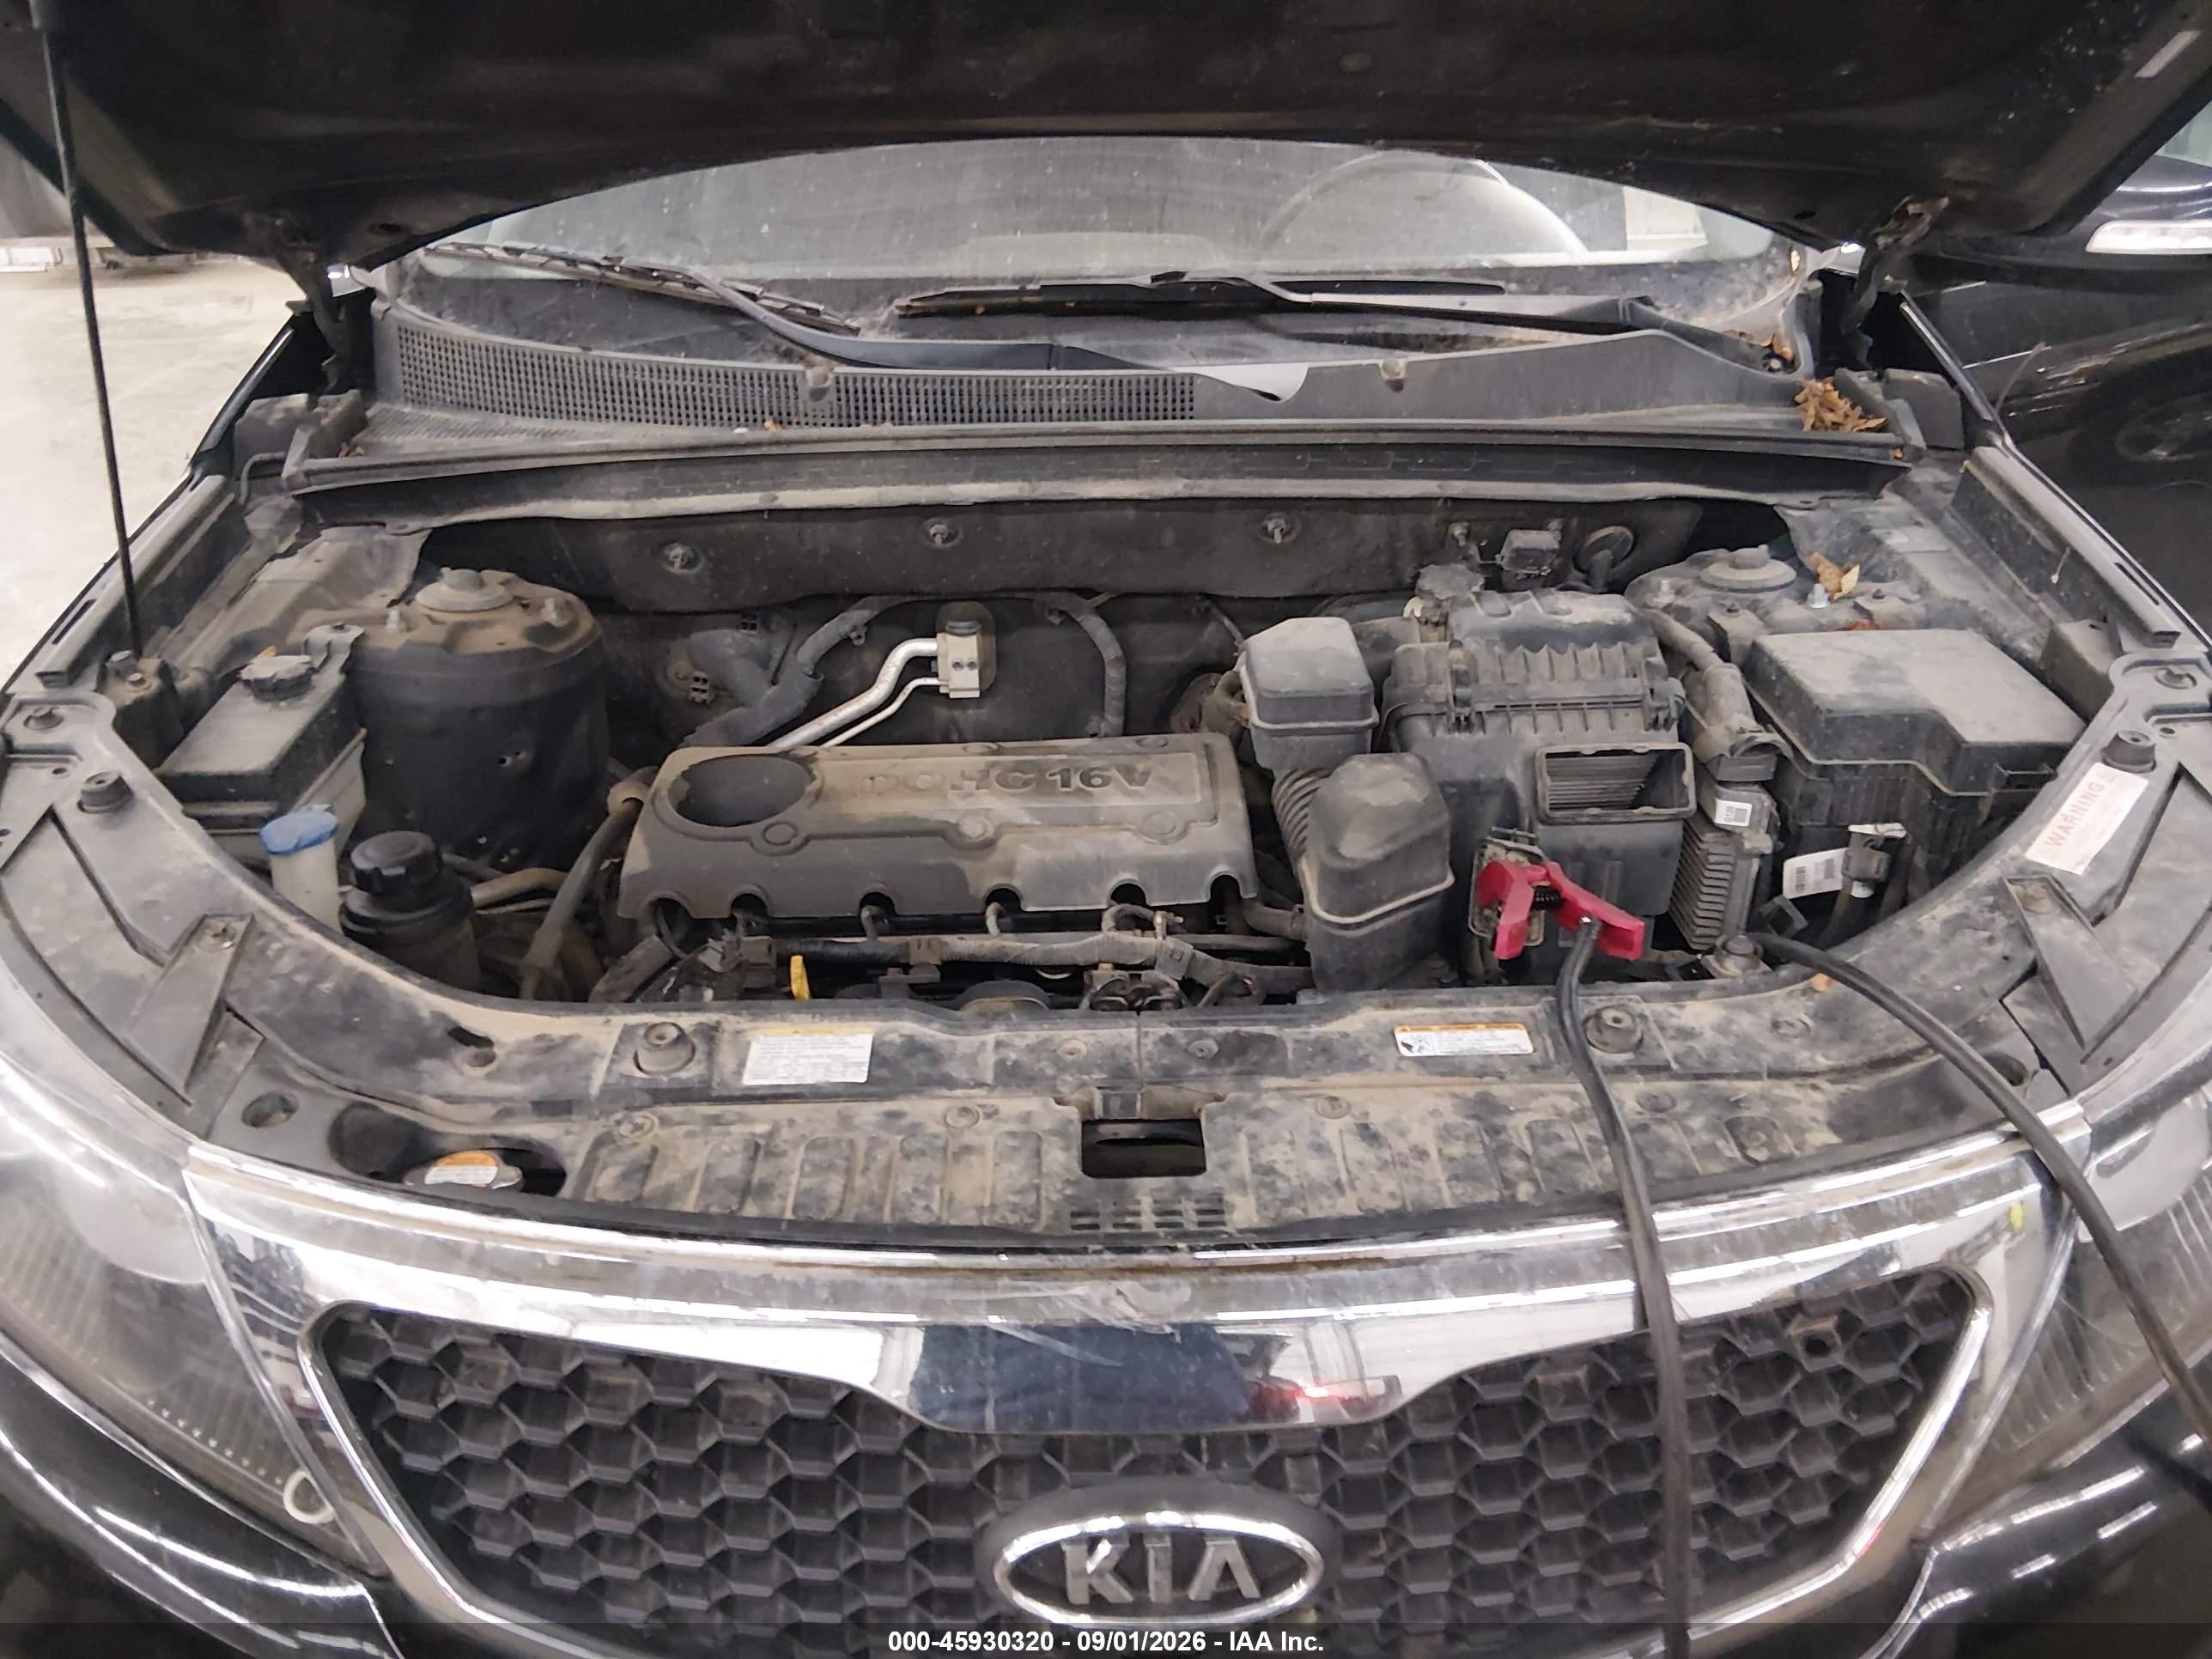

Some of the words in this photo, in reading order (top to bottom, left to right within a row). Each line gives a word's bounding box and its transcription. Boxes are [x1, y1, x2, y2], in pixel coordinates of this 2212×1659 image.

[1047, 766, 1155, 793] 16V
[2045, 781, 2106, 848] WARNING
[1060, 1532, 1261, 1605] KIA
